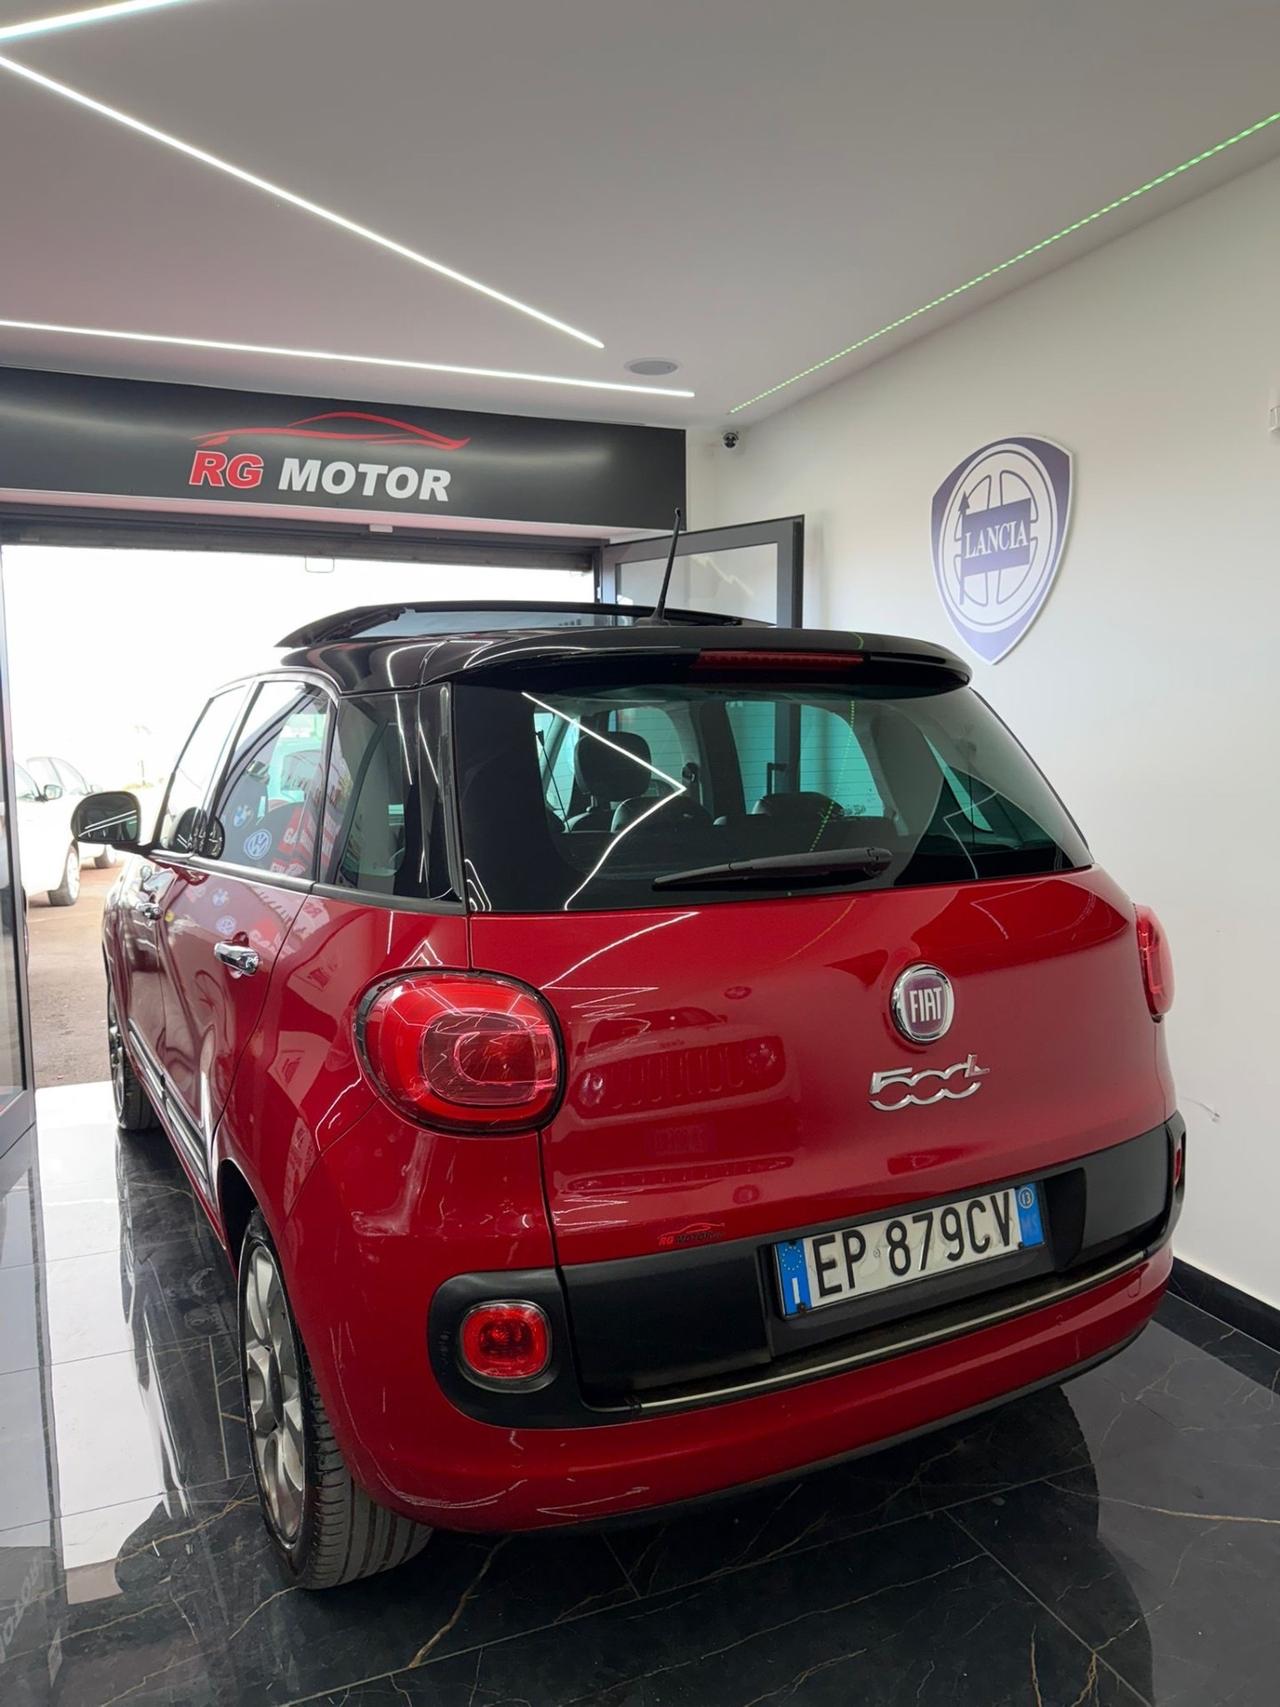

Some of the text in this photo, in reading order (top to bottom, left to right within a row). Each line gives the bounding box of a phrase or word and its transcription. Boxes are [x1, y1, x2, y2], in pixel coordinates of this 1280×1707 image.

[189, 450, 451, 501] RG MOTOR
[964, 519, 1029, 559] LANCIA
[909, 986, 942, 1023] FIAT
[869, 1054, 990, 1111] 500L
[812, 1192, 1012, 1298] EP 879CV
[791, 1277, 801, 1304] I
